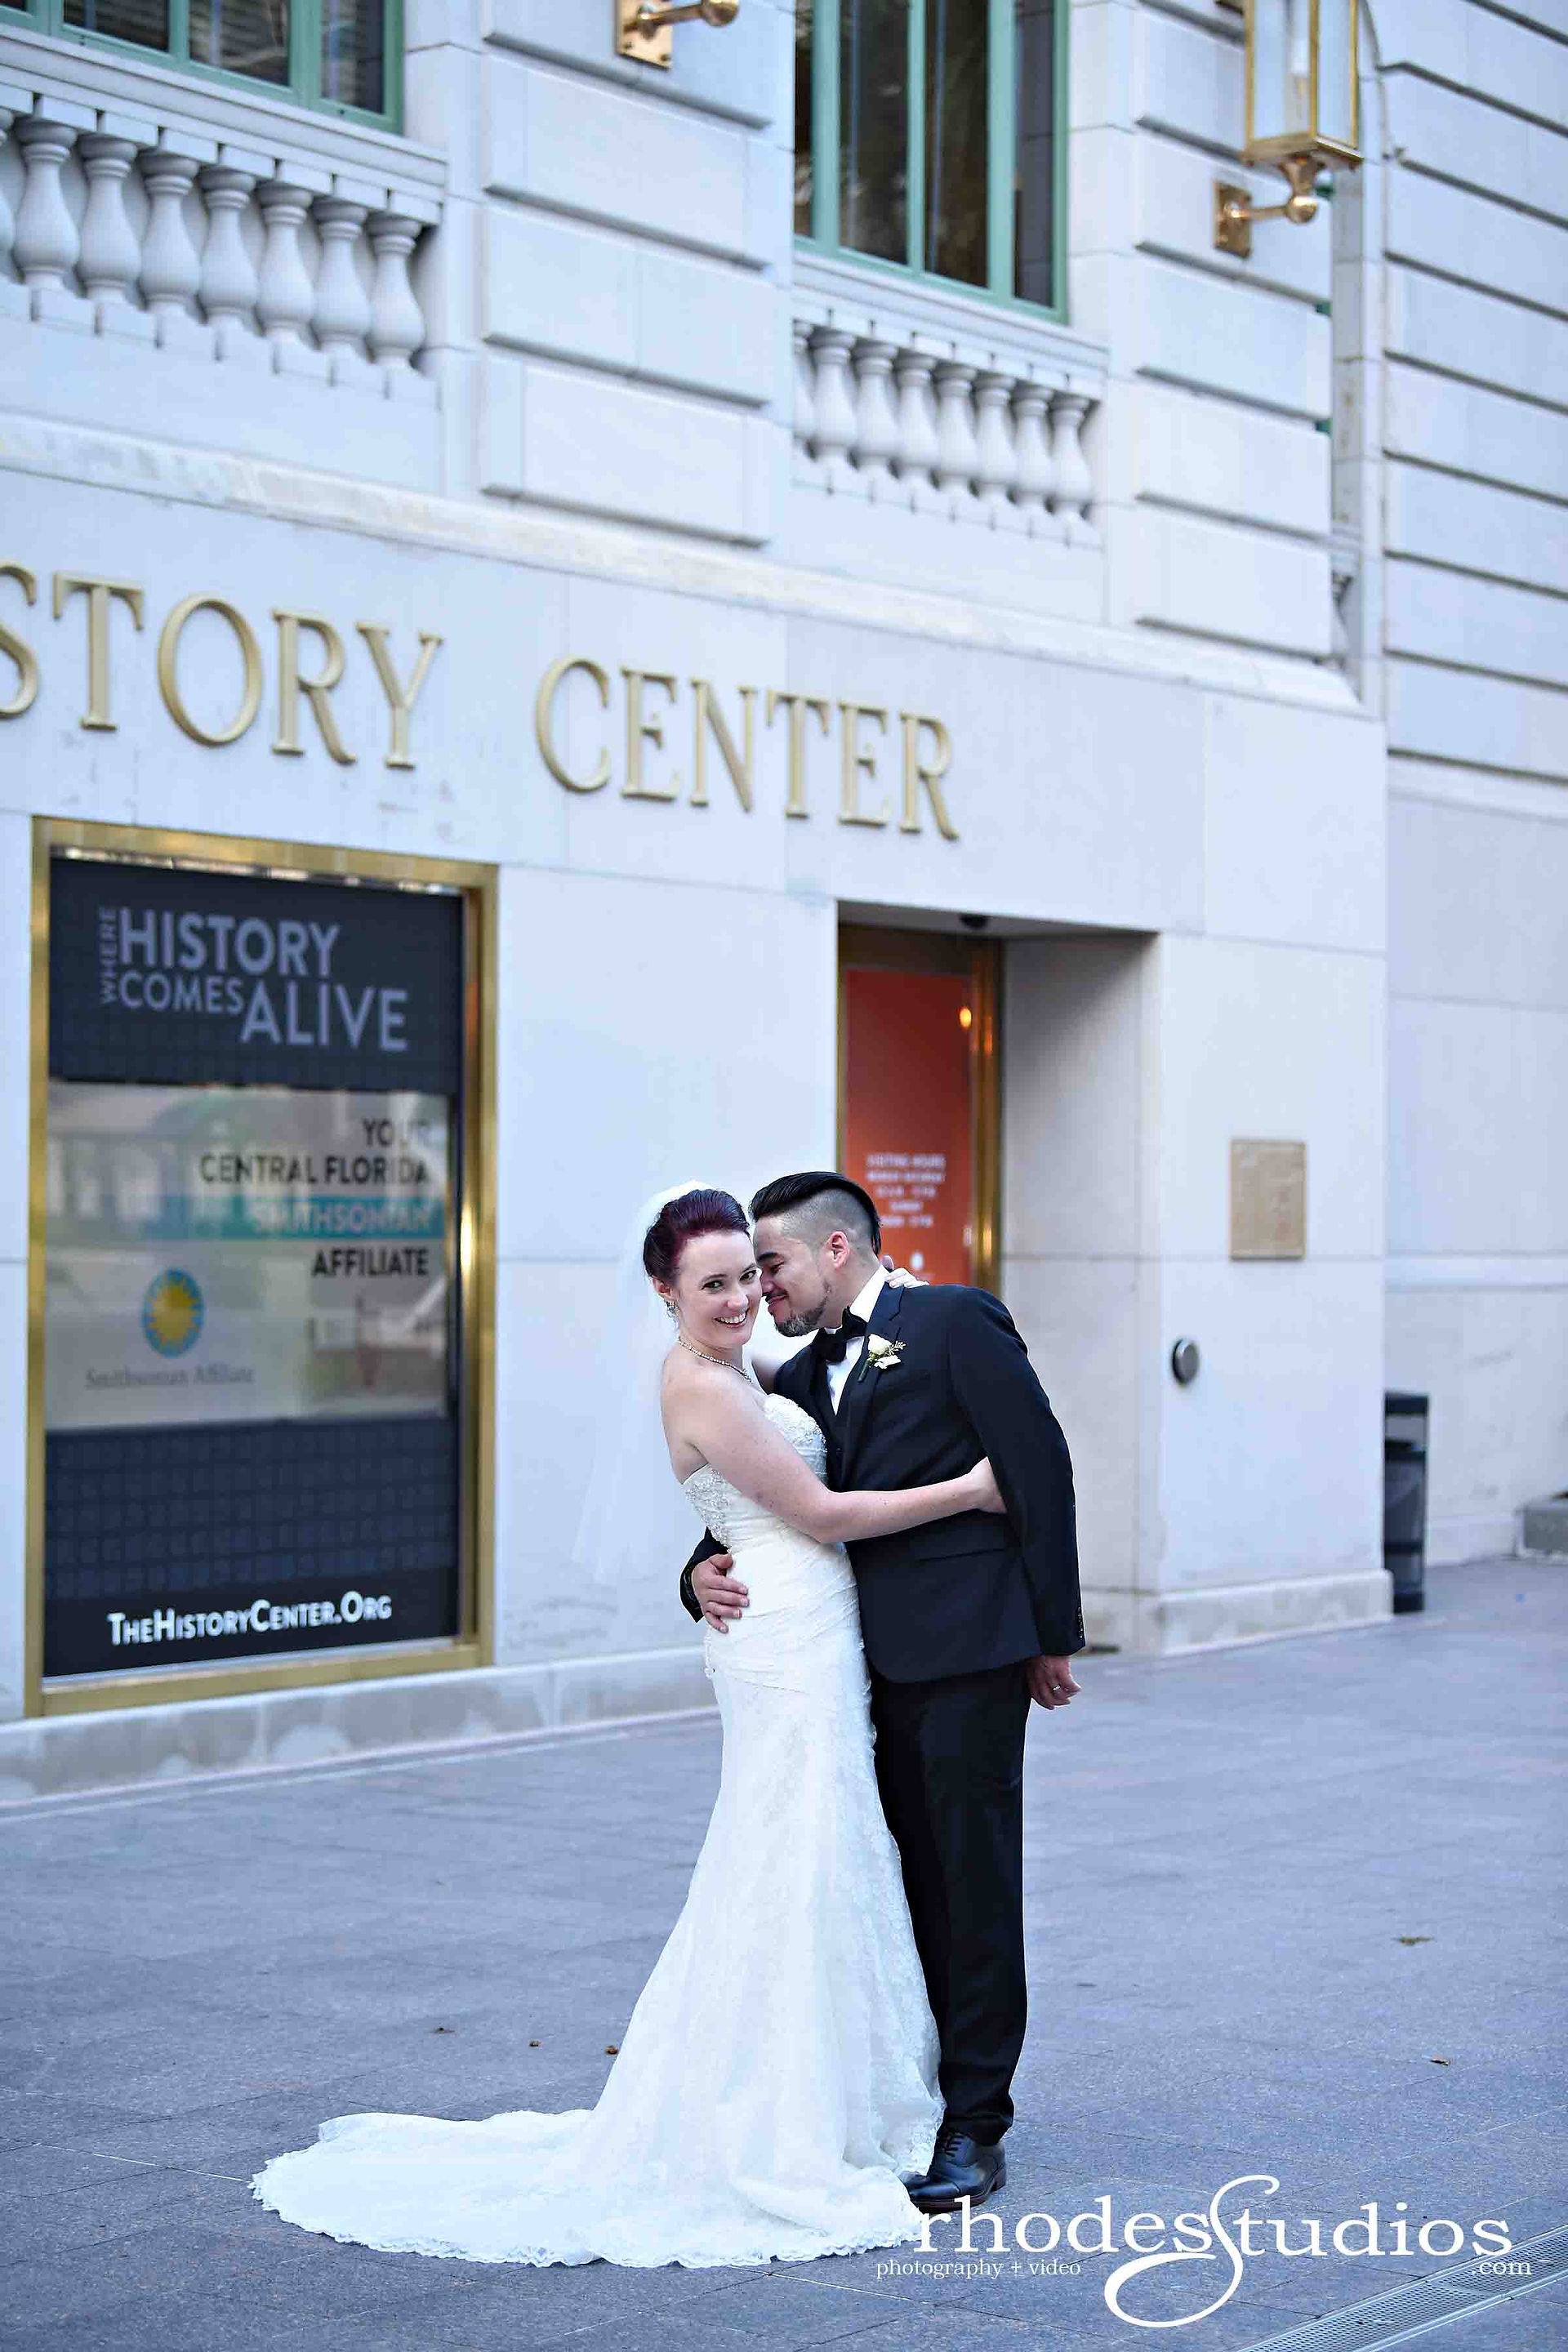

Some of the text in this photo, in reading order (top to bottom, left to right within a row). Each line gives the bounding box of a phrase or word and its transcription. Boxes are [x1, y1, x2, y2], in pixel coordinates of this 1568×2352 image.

[535, 656, 959, 842] CENTER
[99, 906, 117, 1004] WHERE
[119, 906, 341, 978] HISTORY
[119, 970, 408, 1053] COMES ALIVE
[199, 1155, 318, 1184] CENTRAL
[311, 1246, 430, 1278] AFFILIATE
